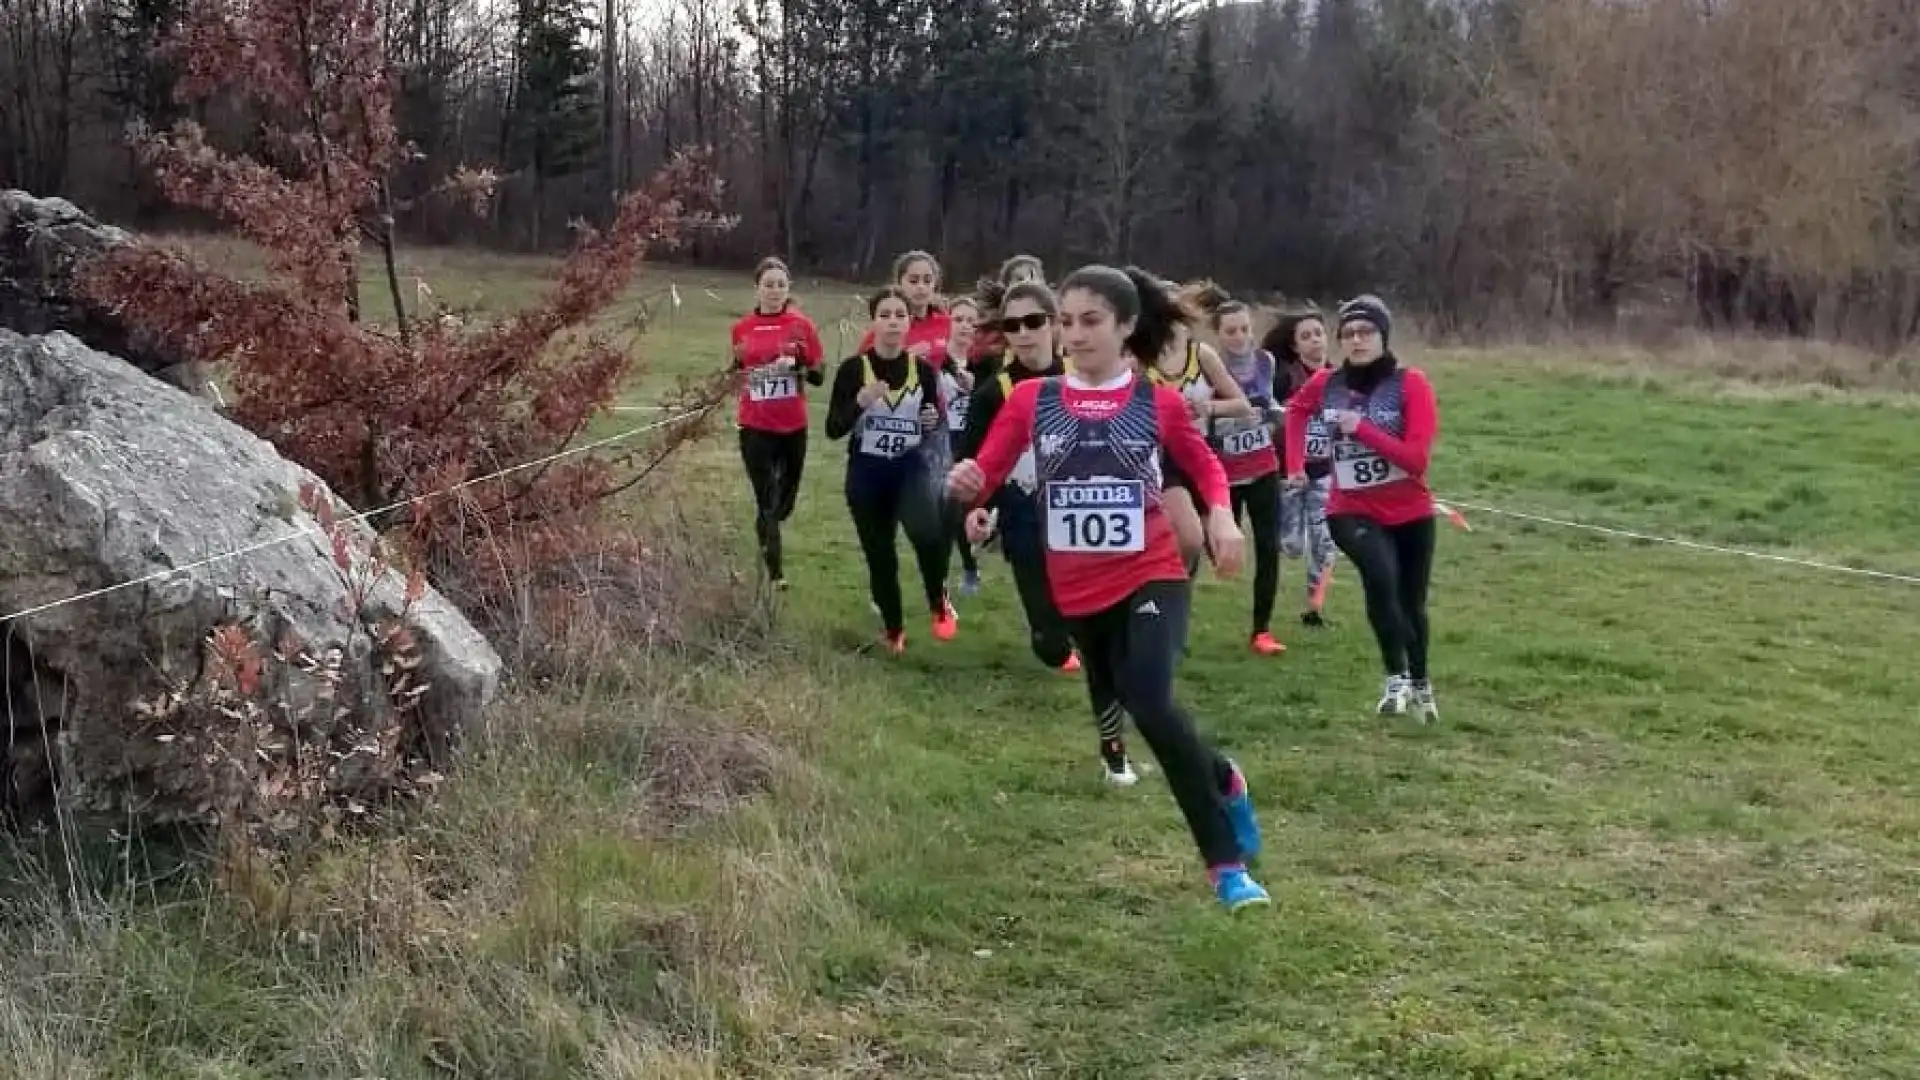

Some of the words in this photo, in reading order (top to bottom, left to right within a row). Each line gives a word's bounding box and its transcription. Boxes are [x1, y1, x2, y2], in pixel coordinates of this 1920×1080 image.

[874, 434, 906, 454] 48
[1231, 427, 1266, 453] 104
[1306, 438, 1329, 456] 02
[1353, 458, 1390, 484] 89
[1053, 485, 1135, 507] joma
[1062, 512, 1133, 547] 103
